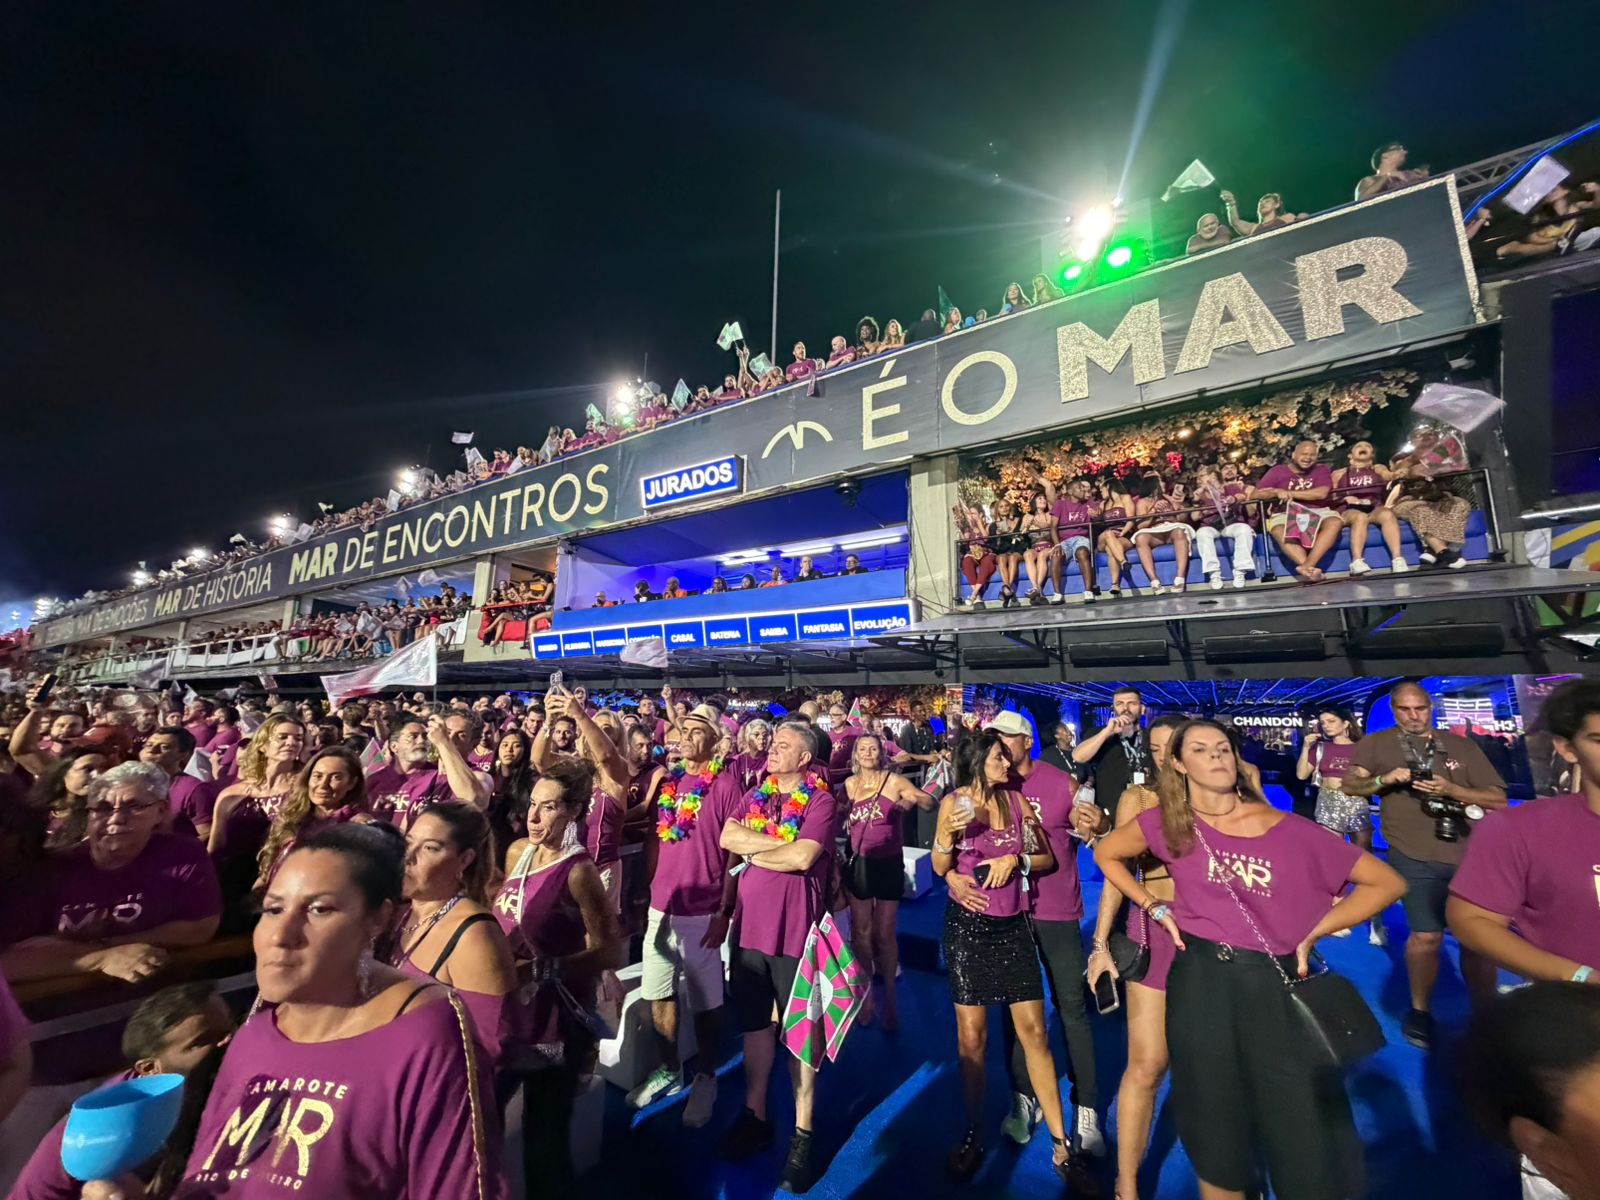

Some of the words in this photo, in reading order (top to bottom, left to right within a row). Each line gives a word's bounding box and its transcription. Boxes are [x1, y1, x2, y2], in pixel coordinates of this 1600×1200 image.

[862, 359, 910, 451] É
[941, 350, 1018, 426] O
[1056, 235, 1423, 404] MAR
[646, 462, 733, 500] JURADOS
[288, 541, 339, 584] MAR
[342, 530, 379, 574] DE
[382, 463, 610, 564] ENCONTROS
[153, 588, 182, 617] MAR
[182, 582, 205, 611] DE
[203, 562, 272, 607] HISTÓRIA
[803, 622, 845, 634] FANTASIA
[853, 616, 907, 631] EVOLUÇÃO
[670, 633, 696, 643] CASAL
[710, 629, 741, 640] BATERIA
[760, 626, 789, 637] SAMBA
[1233, 716, 1303, 727] CHANDON
[249, 1077, 348, 1100] AMAROTE
[228, 1168, 250, 1180] DE
